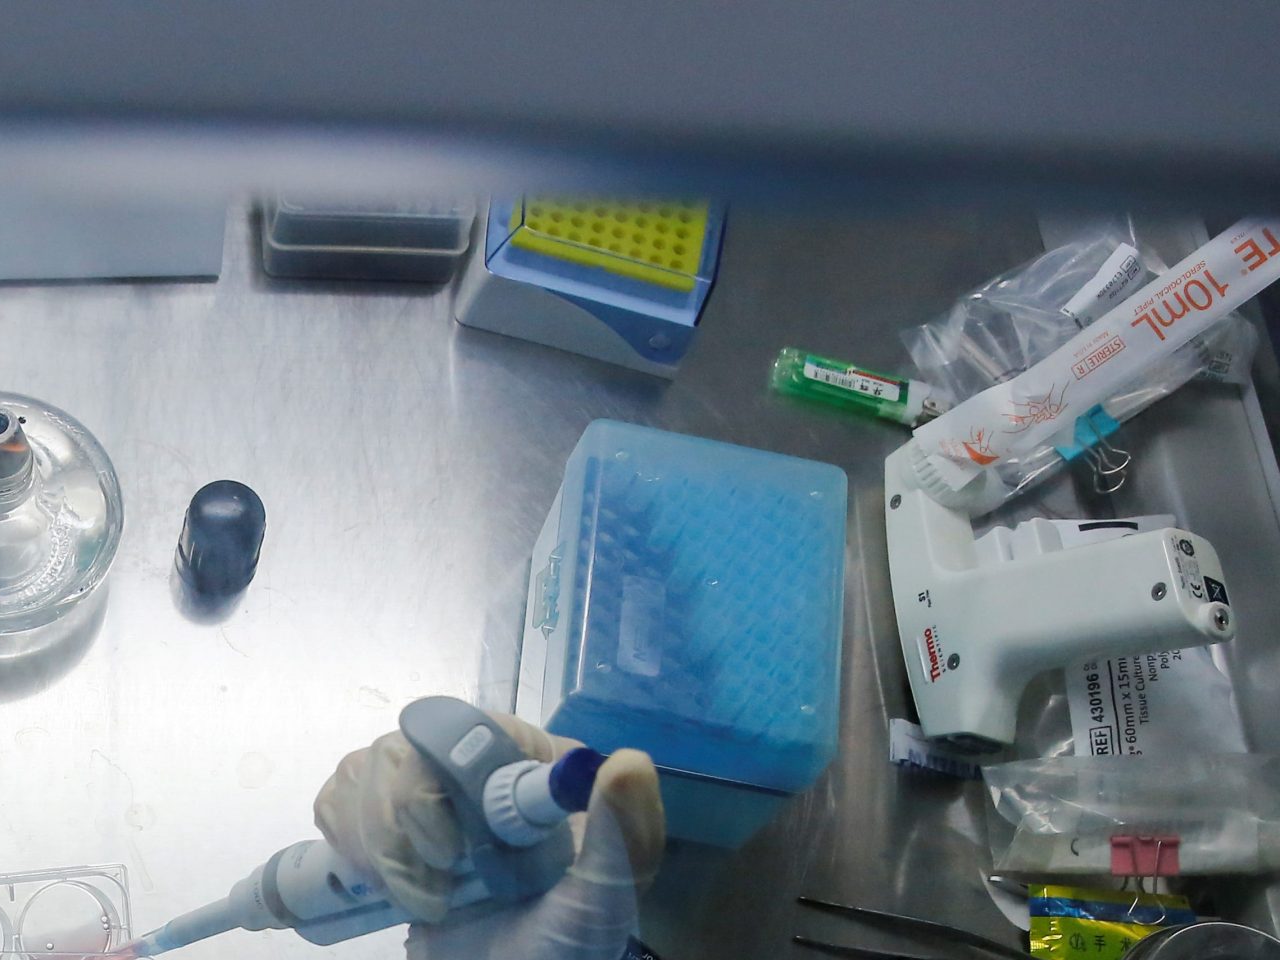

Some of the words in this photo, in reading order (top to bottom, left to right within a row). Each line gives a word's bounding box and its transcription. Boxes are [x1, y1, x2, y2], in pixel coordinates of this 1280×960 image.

[1153, 260, 1207, 299] SEROLOGICAL
[1130, 269, 1230, 341] 10mL
[1133, 298, 1155, 316] PIPET
[1088, 339, 1121, 367] STERILE
[924, 628, 941, 683] Thermo
[1133, 656, 1146, 691] Culture
[1086, 673, 1105, 722] 430196
[1122, 692, 1132, 700] x
[1138, 693, 1149, 725] Tissue
[1123, 703, 1137, 743] 60mm
[1094, 730, 1109, 755] REF
